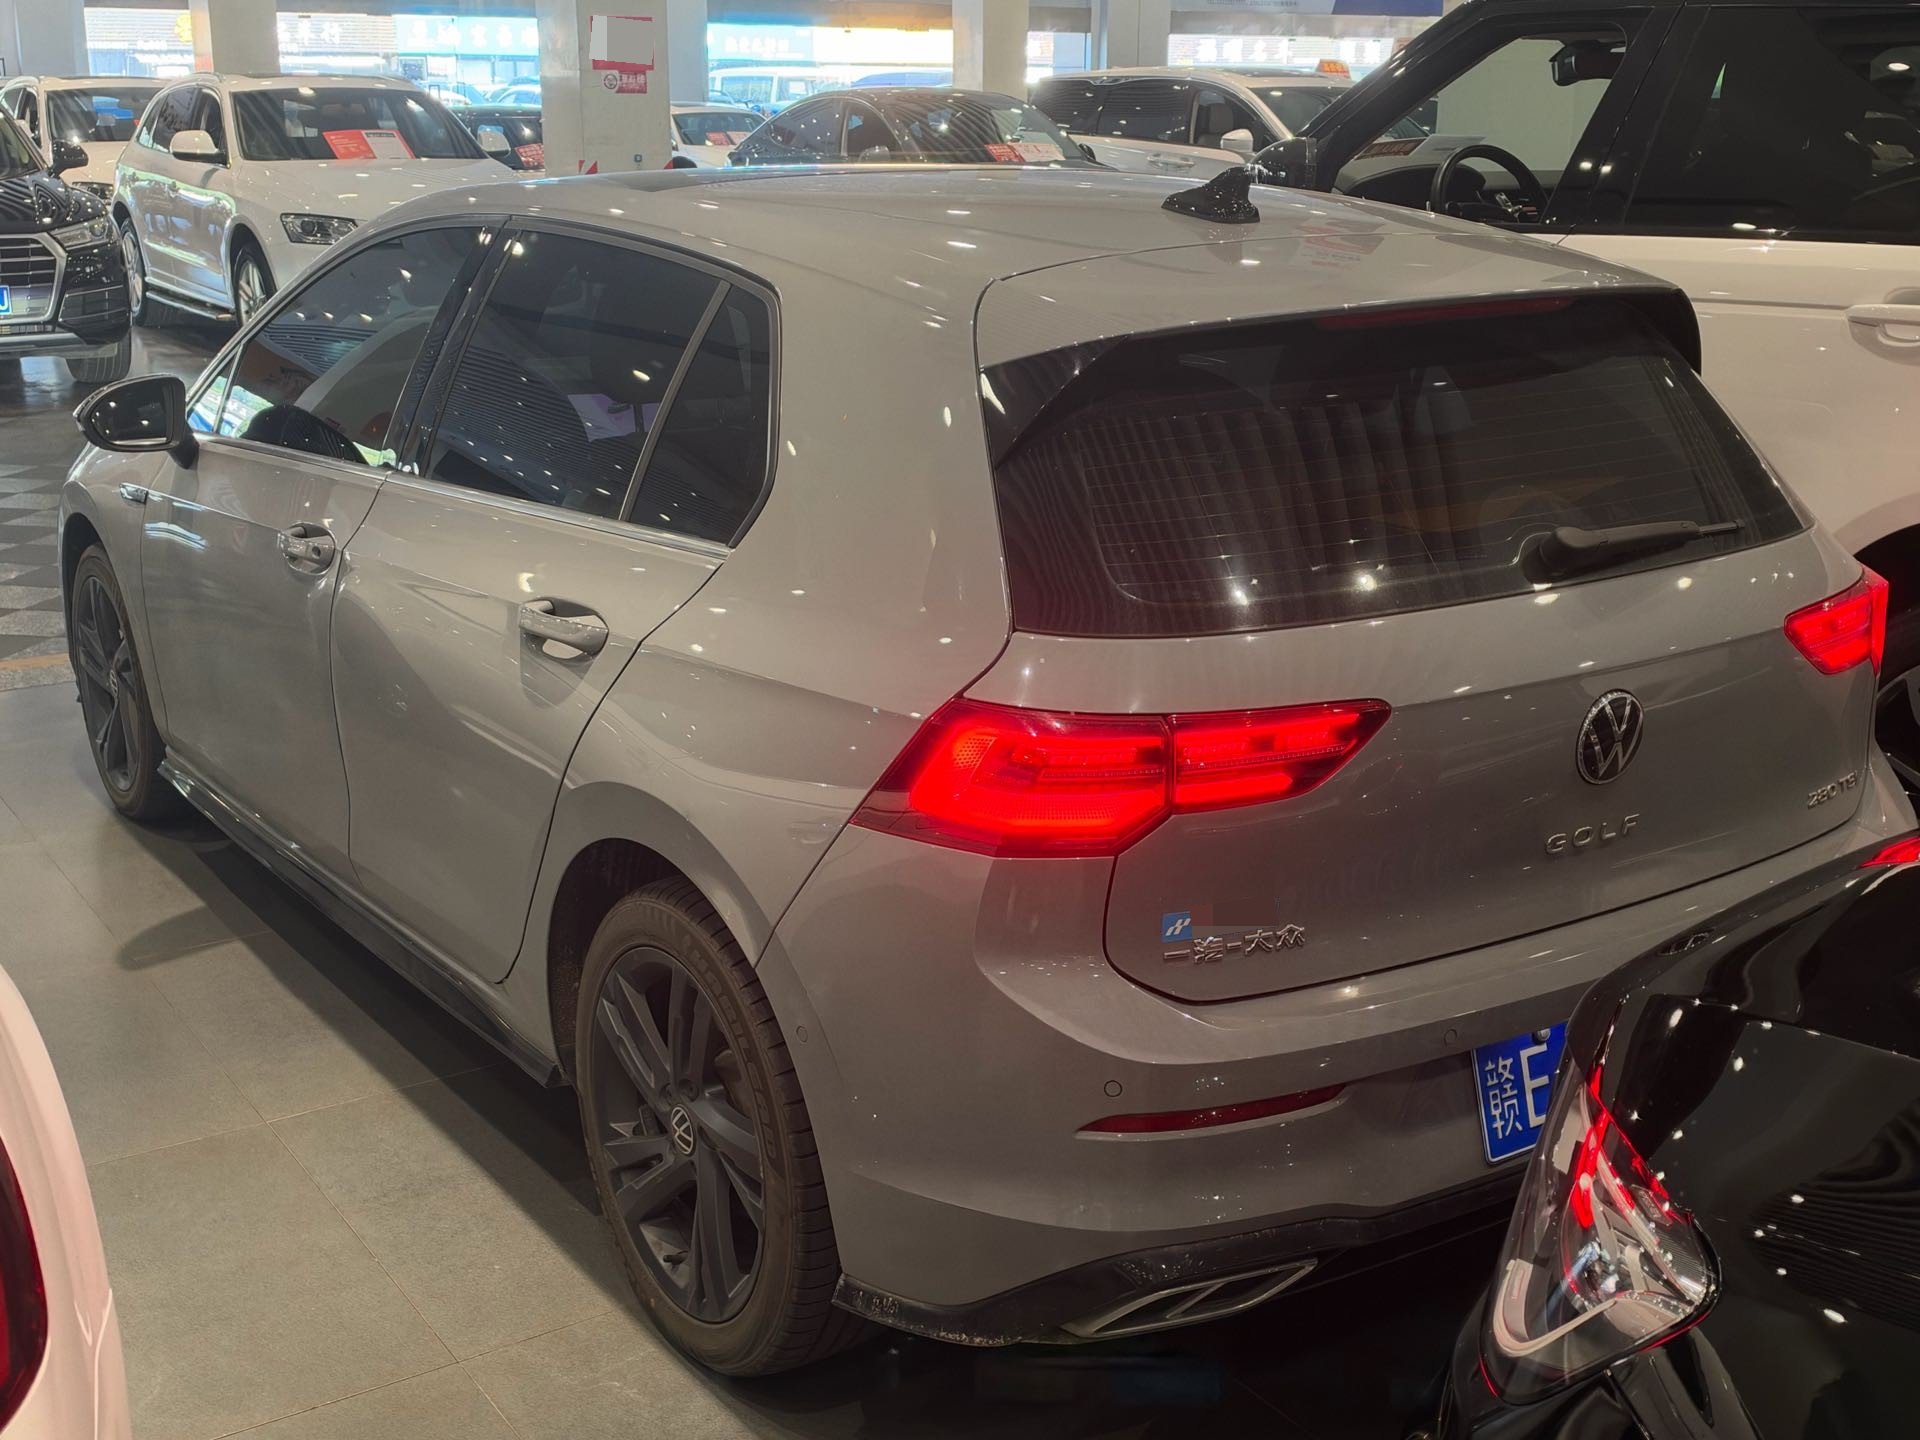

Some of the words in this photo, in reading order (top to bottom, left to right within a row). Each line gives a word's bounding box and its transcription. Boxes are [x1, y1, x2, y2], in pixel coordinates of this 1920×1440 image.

[1546, 813, 1640, 854] GOLF
[1163, 923, 1305, 964] 一汽-大众
